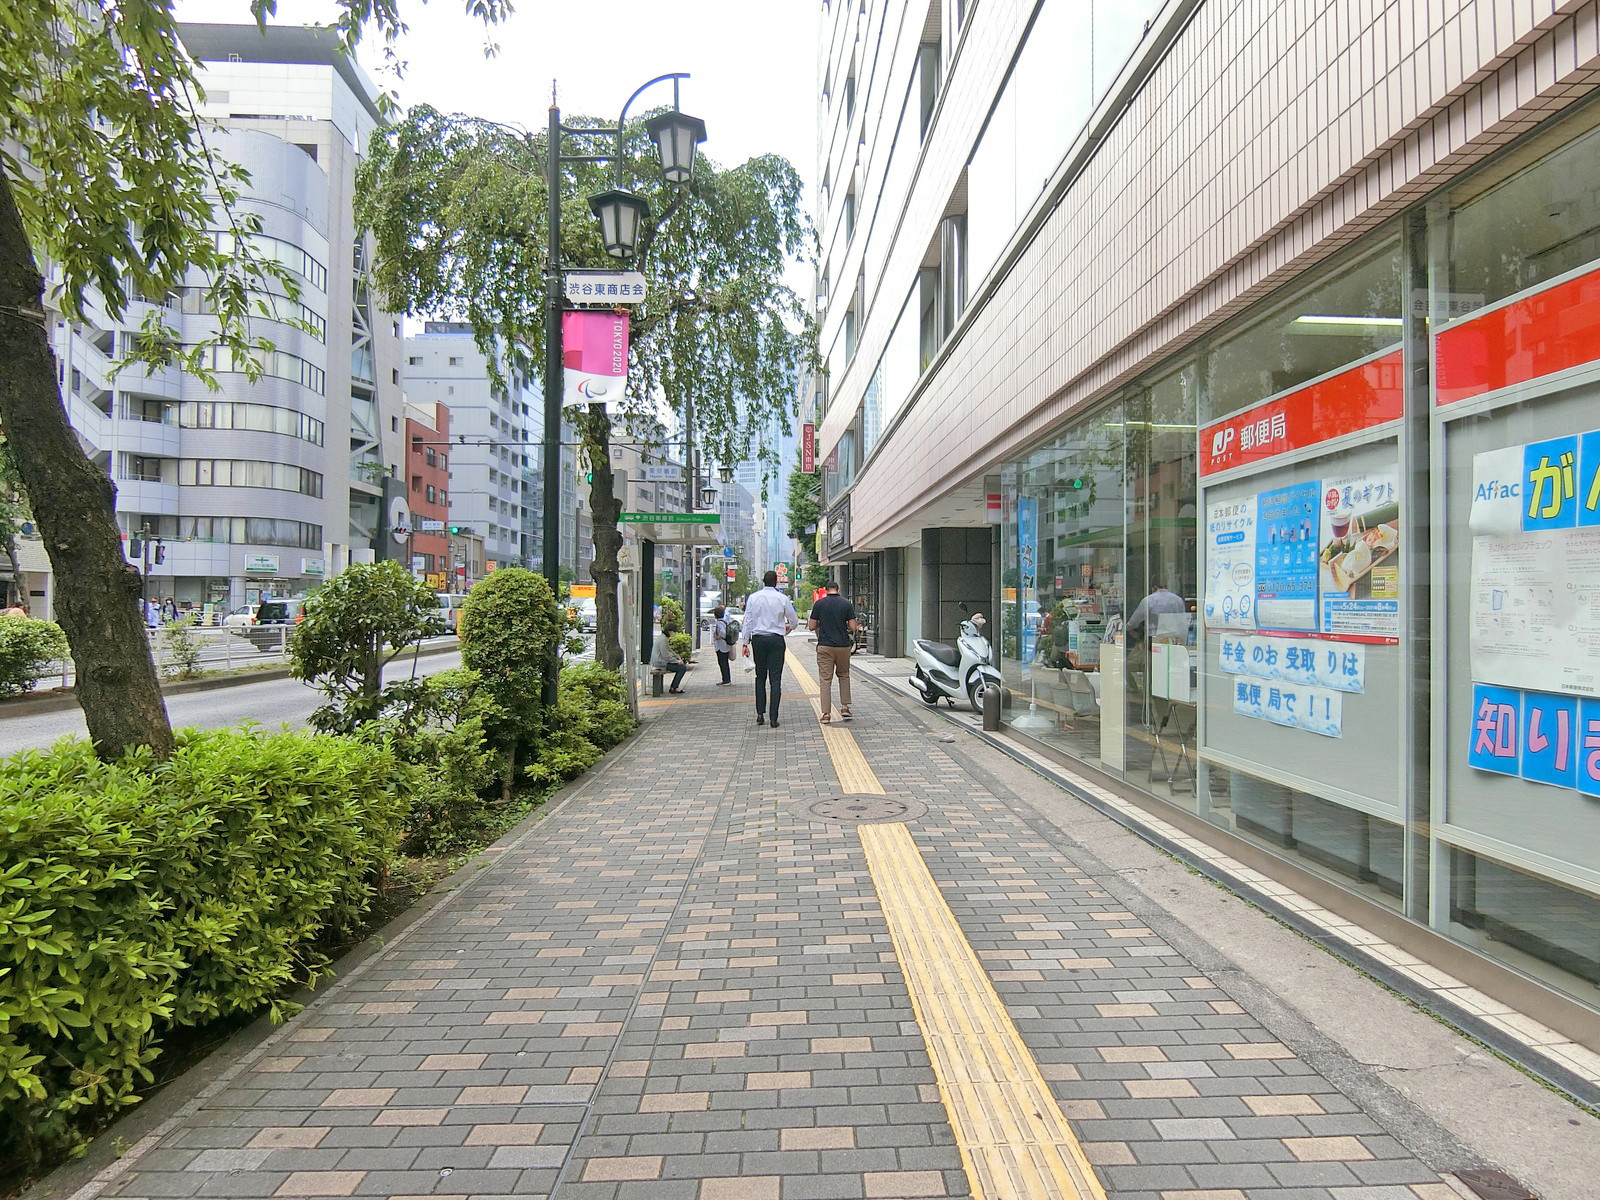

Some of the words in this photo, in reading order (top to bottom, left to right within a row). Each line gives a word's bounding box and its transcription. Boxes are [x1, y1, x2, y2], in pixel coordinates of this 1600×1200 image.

[569, 283, 644, 295] 渋谷東商店会
[613, 319, 623, 350] TOKYO
[612, 352, 622, 374] 2020
[1240, 413, 1286, 452] 郵便局
[1210, 453, 1233, 465] POST
[1342, 481, 1394, 509] 夏のギフト
[1474, 480, 1520, 502] Aflac
[1213, 504, 1247, 519] 日本郵便の
[1209, 517, 1254, 533] 紙のリサイクル
